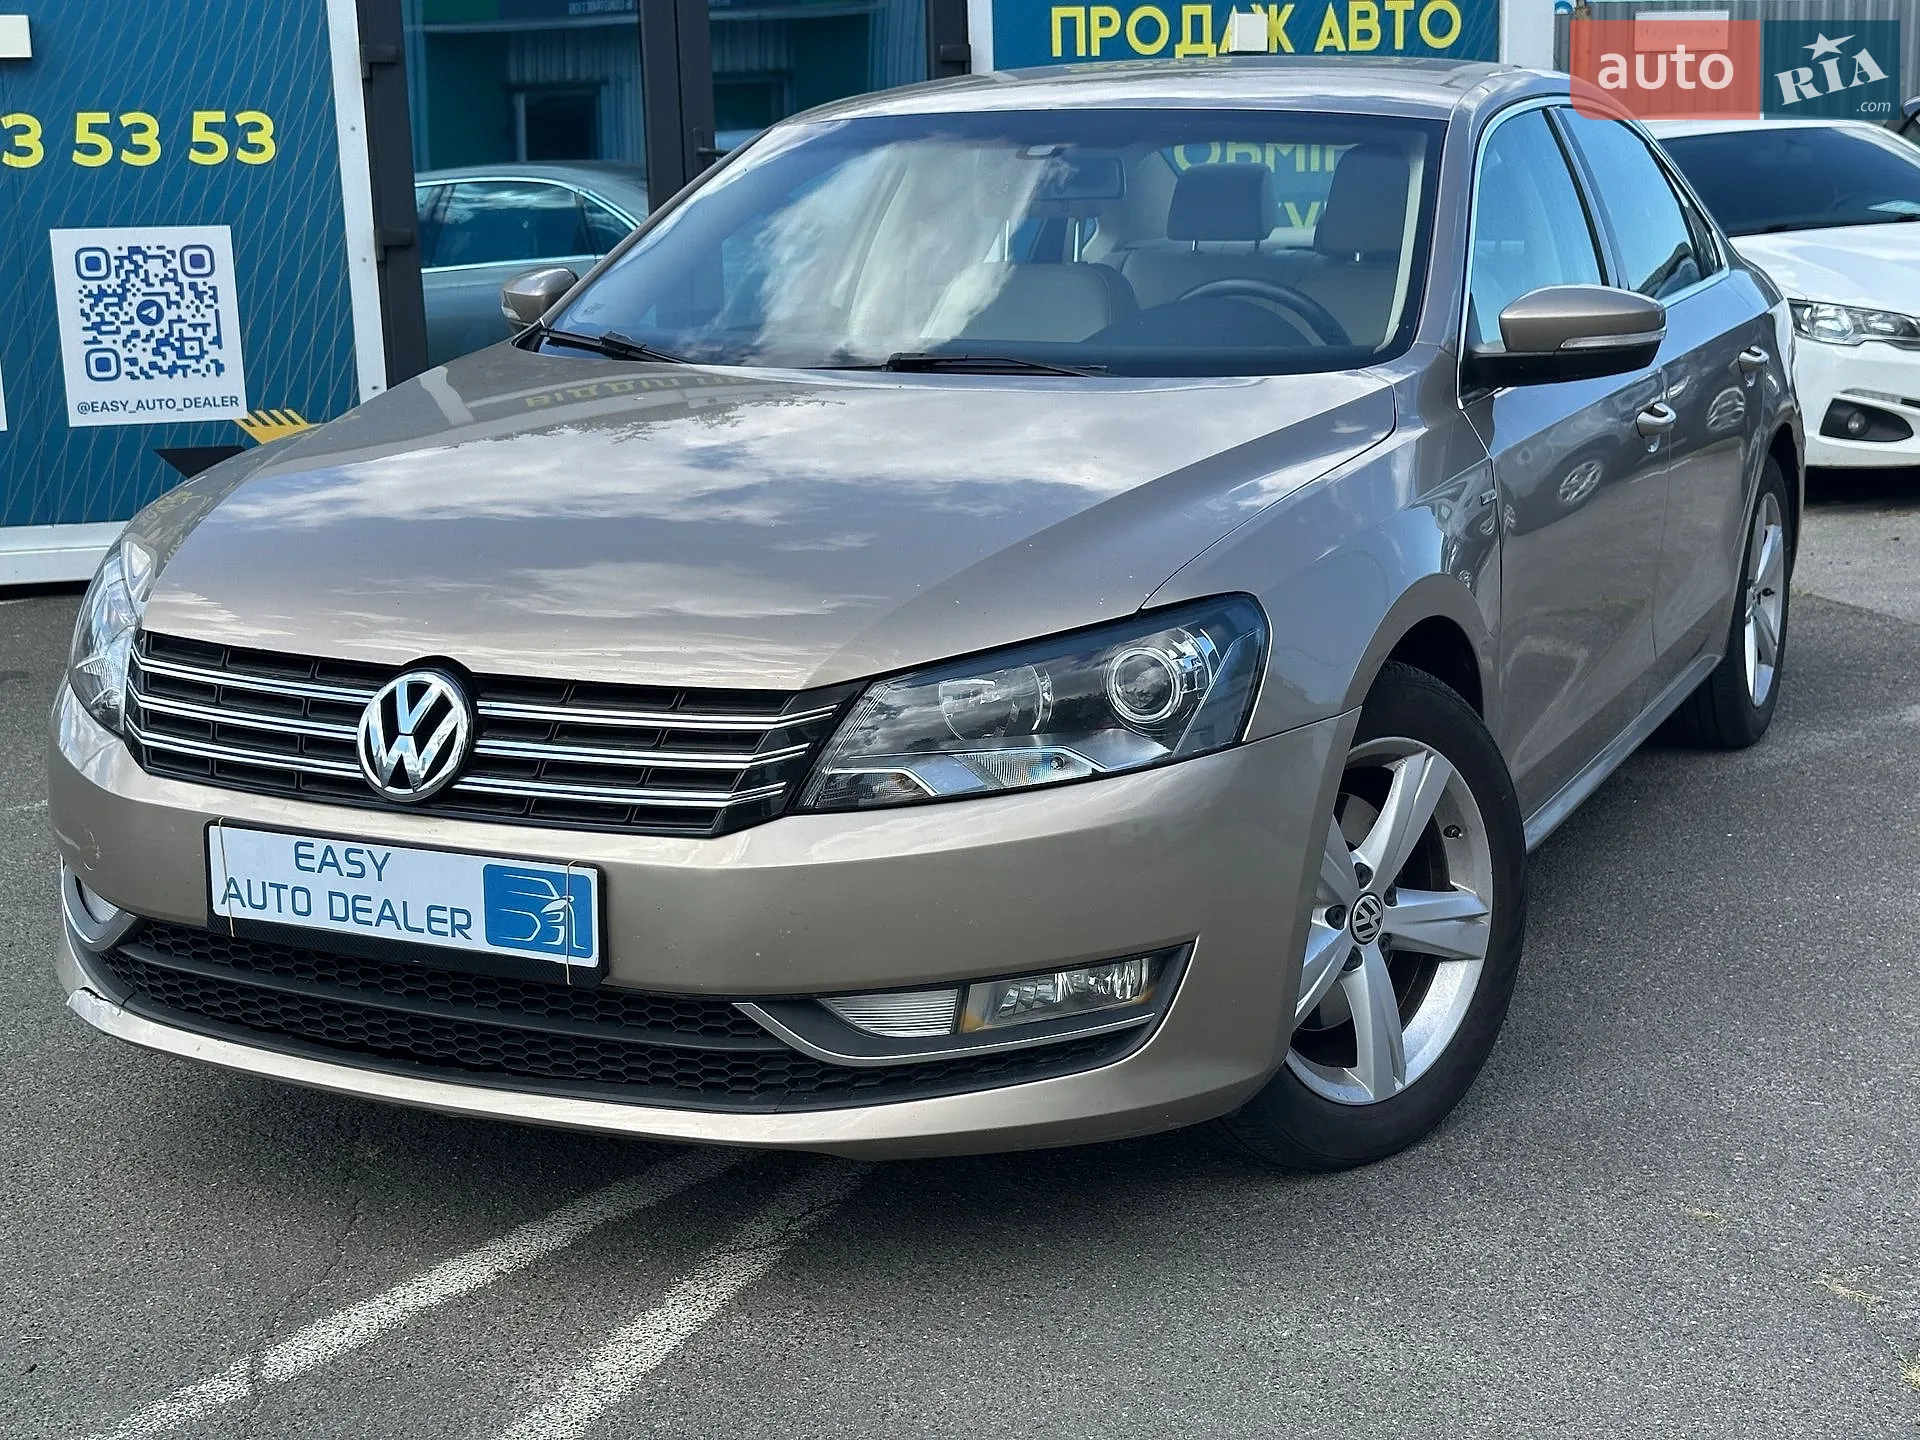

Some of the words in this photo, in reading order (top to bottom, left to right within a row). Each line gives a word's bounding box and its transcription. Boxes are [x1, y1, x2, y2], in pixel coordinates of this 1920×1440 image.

[1314, 0, 1461, 52] АВТО
[72, 112, 161, 168] 53
[189, 111, 276, 166] 53
[77, 395, 240, 415] @EASY_AUTO_DEALER
[294, 840, 392, 882] EASY
[220, 876, 313, 918] AUTO
[327, 890, 473, 941] DEALER
